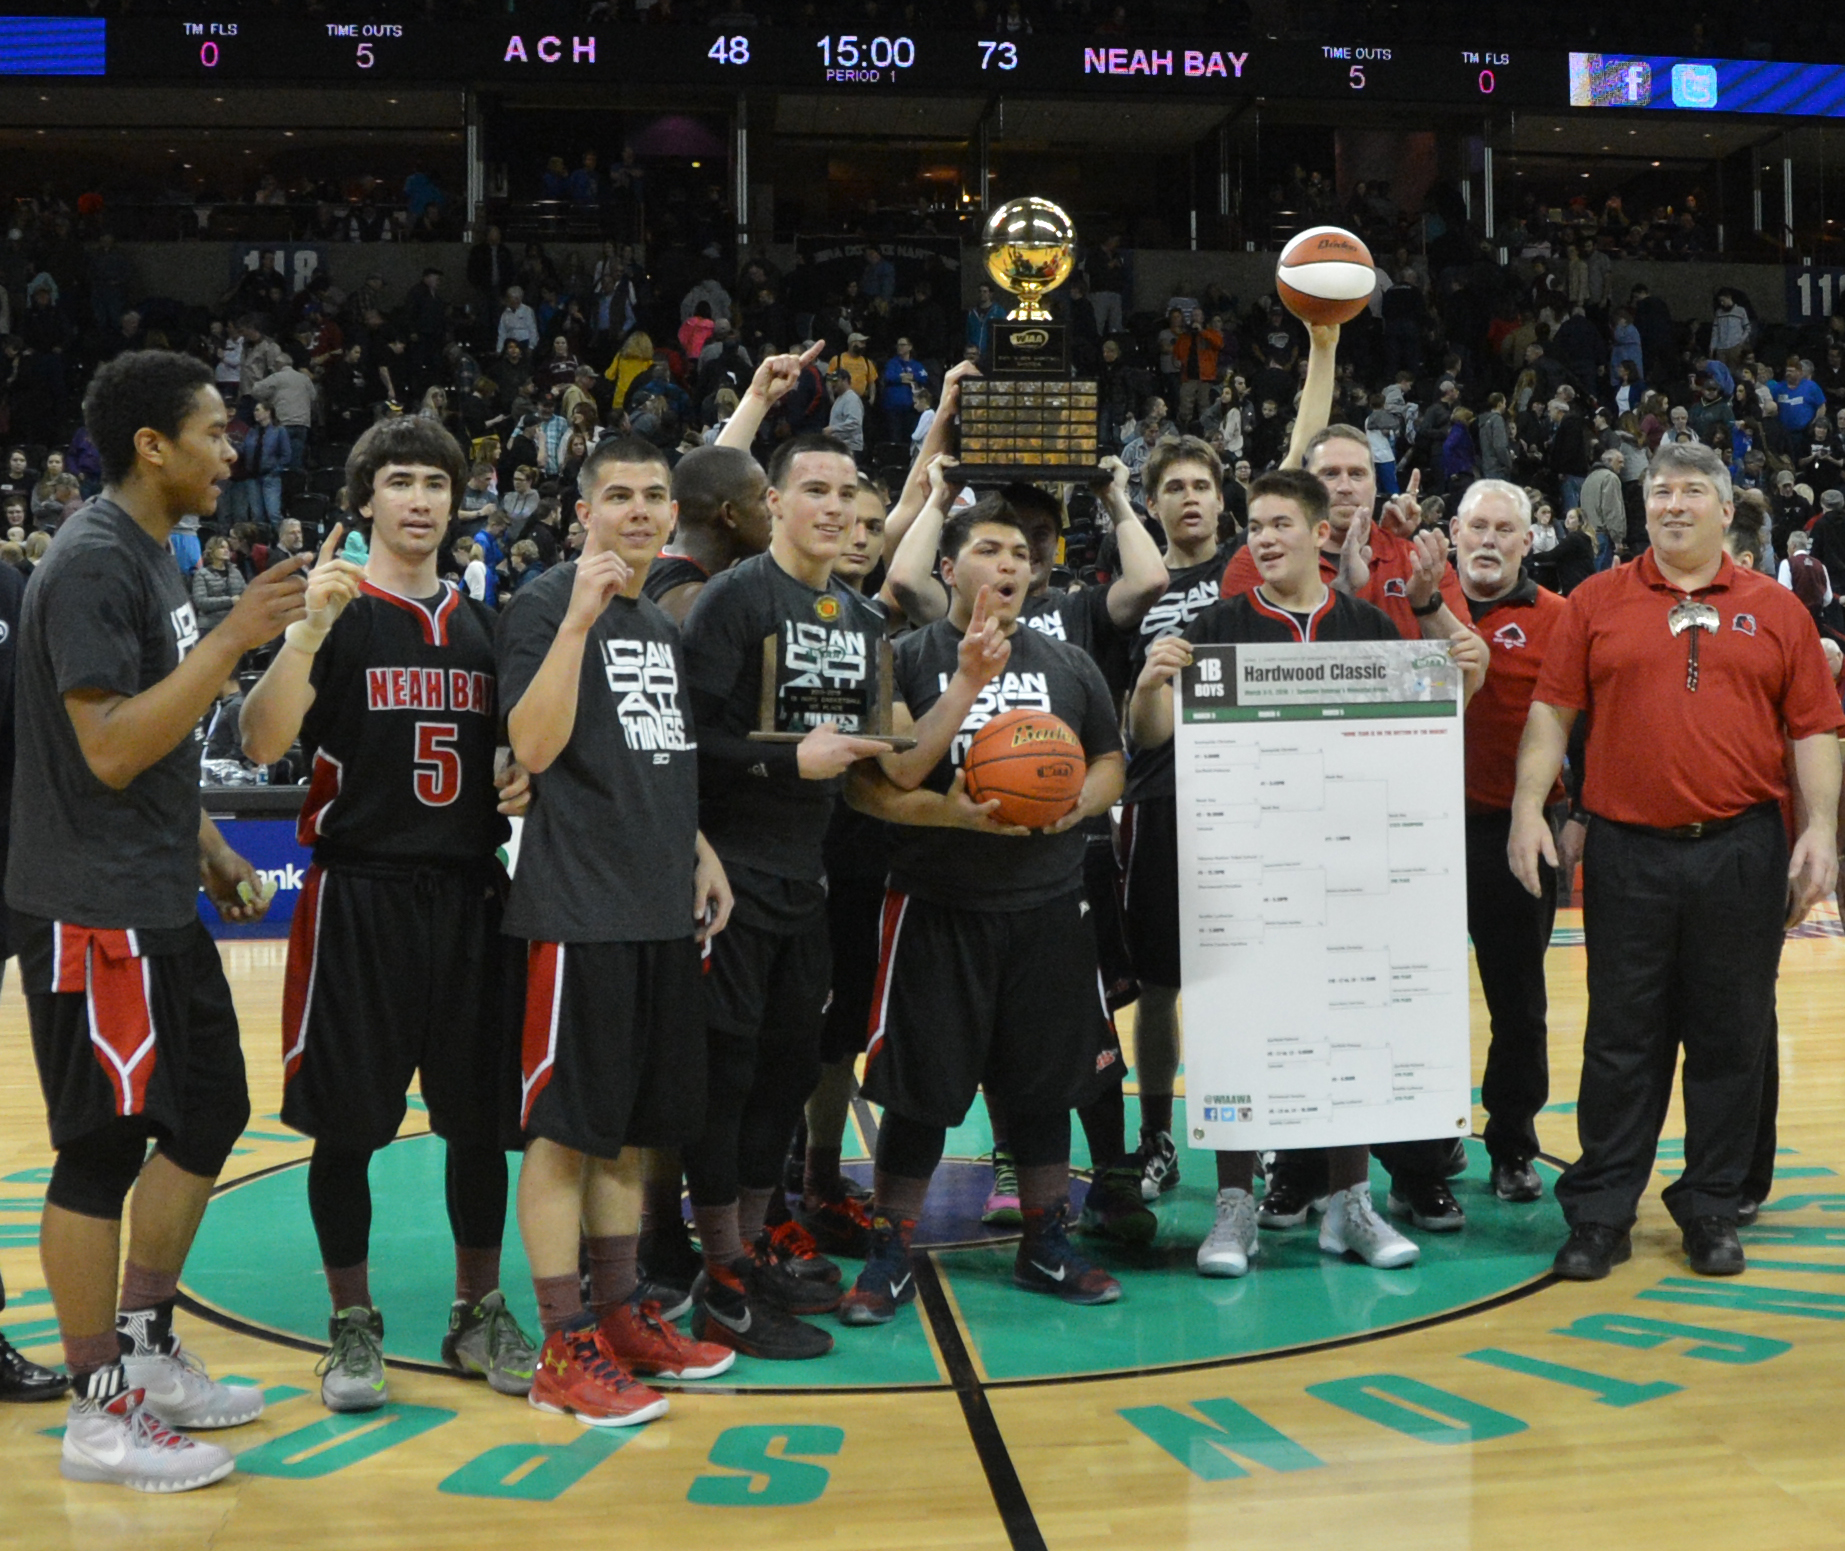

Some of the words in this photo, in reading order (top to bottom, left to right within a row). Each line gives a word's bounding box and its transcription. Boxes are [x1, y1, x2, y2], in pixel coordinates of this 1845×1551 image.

[183, 22, 204, 36] TM
[210, 22, 238, 36] FLS
[326, 23, 358, 37] TIME
[362, 24, 403, 38] OUTS
[199, 41, 219, 67] 0
[356, 42, 374, 69] 5
[707, 35, 751, 65] 48
[816, 35, 916, 68] 15:00
[977, 40, 1019, 71] 73
[1083, 47, 1174, 76] NEAH
[1183, 50, 1249, 78] BAY
[1321, 46, 1352, 60] TIME
[1356, 47, 1392, 61] OUTS
[1461, 51, 1481, 64] TM
[1485, 52, 1510, 66] FLS
[826, 68, 880, 83] PERIOD
[889, 70, 896, 83] 1
[1349, 65, 1366, 90] 5
[1478, 69, 1495, 94] 0
[796, 622, 867, 656] CAN
[607, 639, 676, 669] CAN
[605, 665, 678, 694] DO
[1195, 658, 1224, 683] 1B
[1244, 663, 1325, 682] Hardwood
[1330, 662, 1387, 680] Classic
[366, 667, 445, 711] NEAH
[1194, 682, 1226, 698] BOYS
[617, 691, 682, 722] ALL
[413, 721, 461, 807] 5
[1203, 1094, 1253, 1106] @WIAAWA
